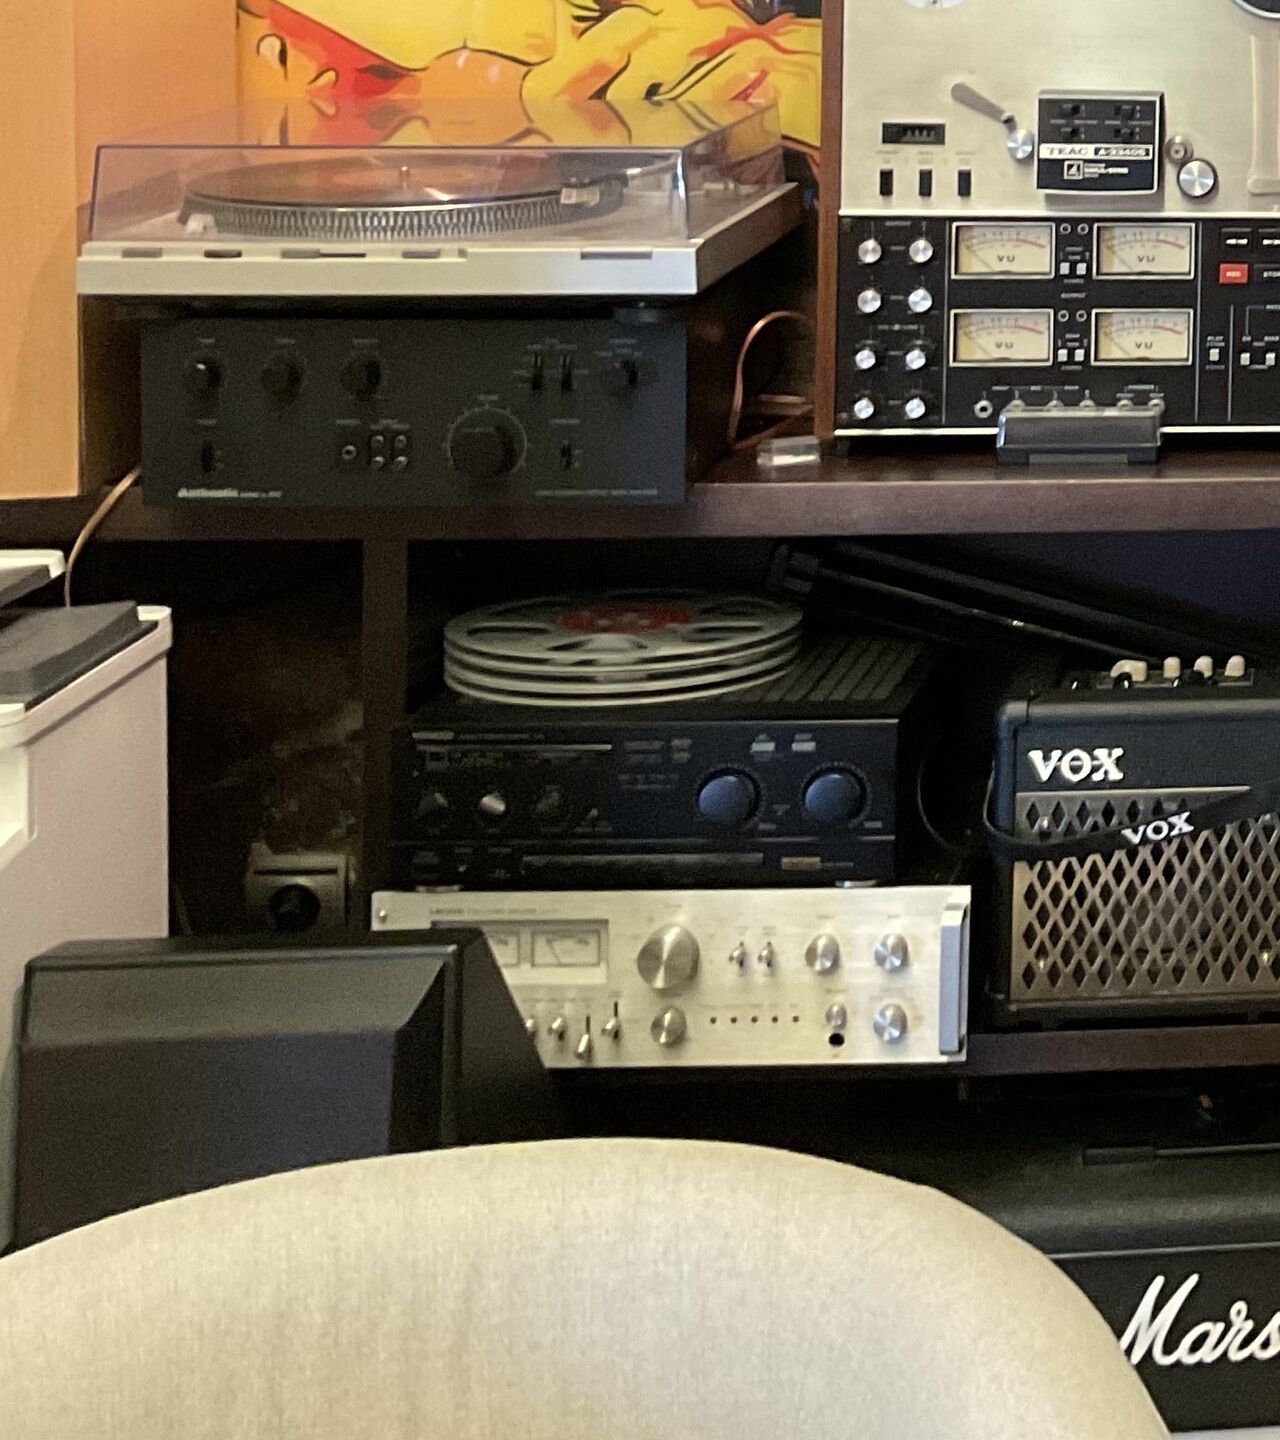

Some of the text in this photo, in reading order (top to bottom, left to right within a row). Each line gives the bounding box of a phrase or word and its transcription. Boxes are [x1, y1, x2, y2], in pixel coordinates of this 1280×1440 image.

[1047, 146, 1089, 157] TEAC
[1027, 747, 1125, 784] VOX
[1120, 810, 1196, 848] VOX
